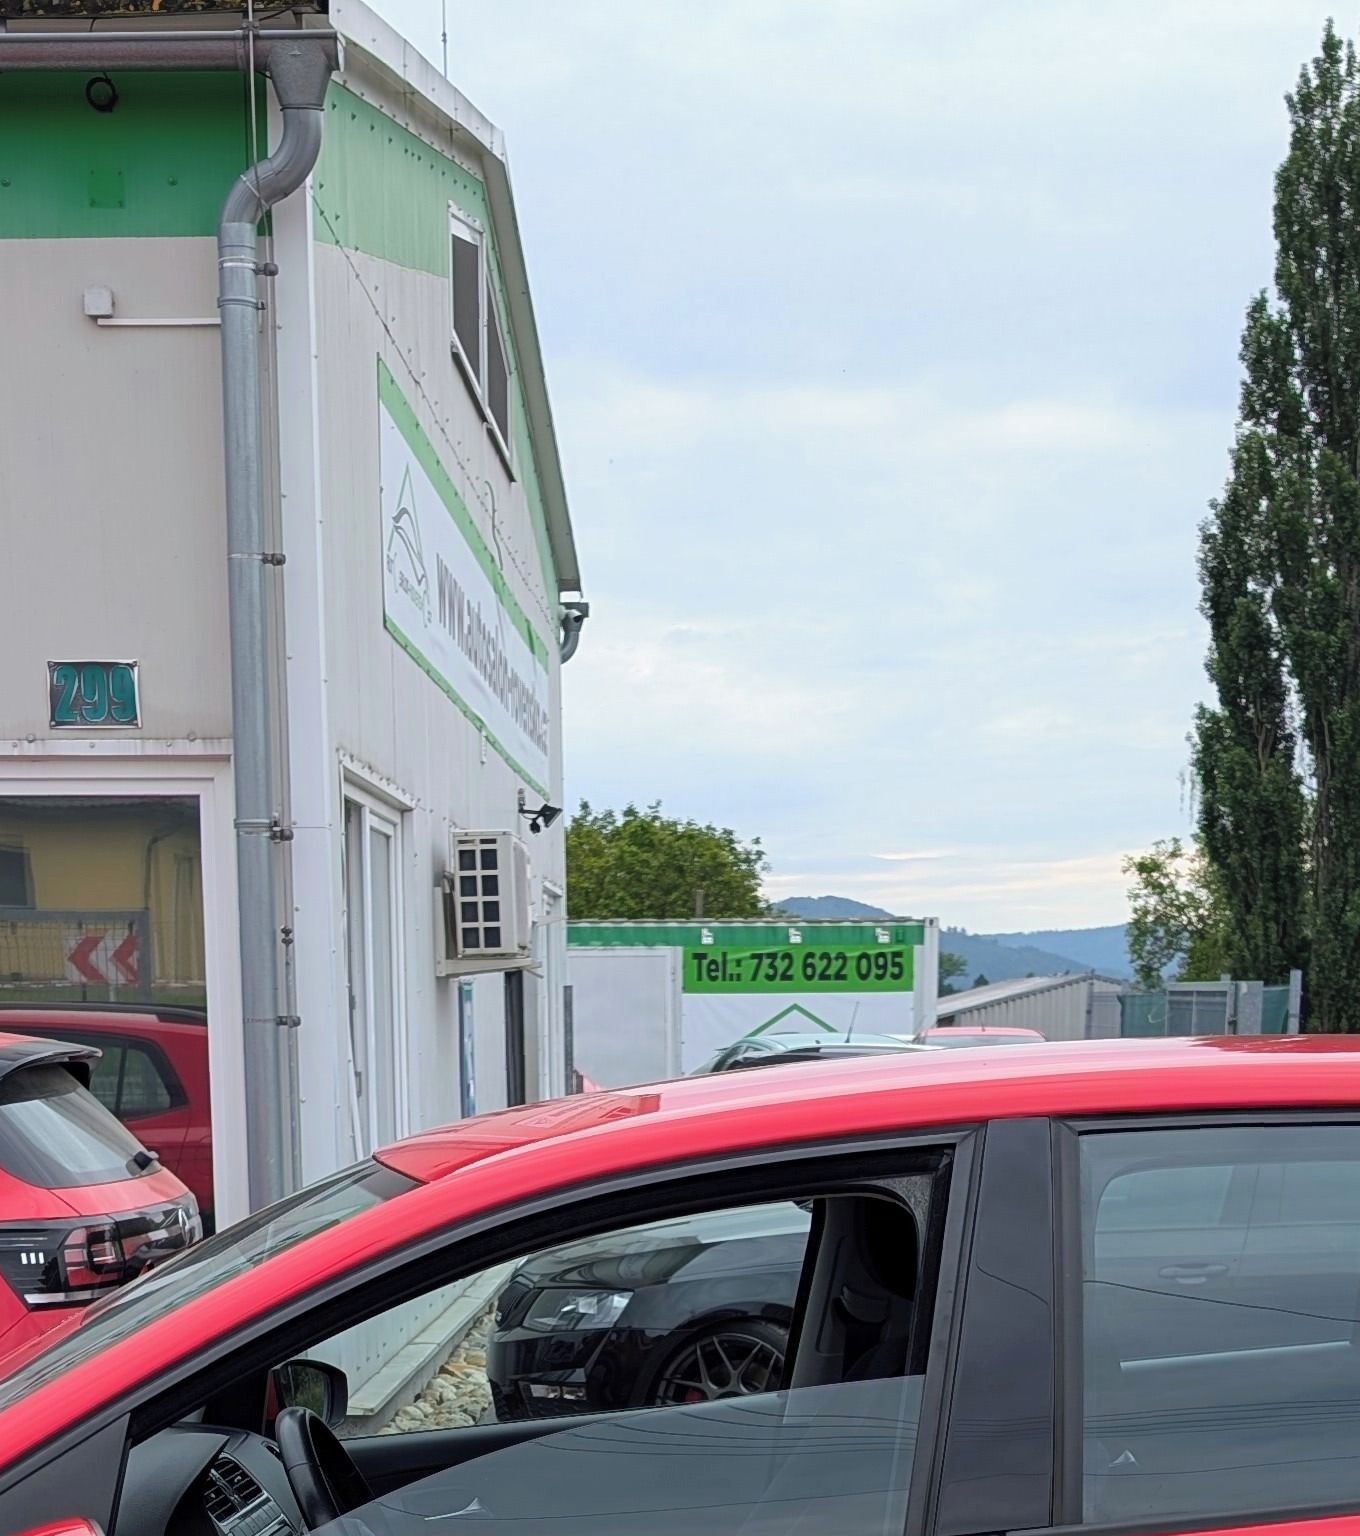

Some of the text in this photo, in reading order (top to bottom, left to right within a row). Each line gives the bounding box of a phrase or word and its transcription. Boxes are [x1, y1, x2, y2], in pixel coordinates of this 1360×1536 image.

[53, 664, 137, 722] 299
[691, 950, 905, 982] Tel.: 732 622 095
